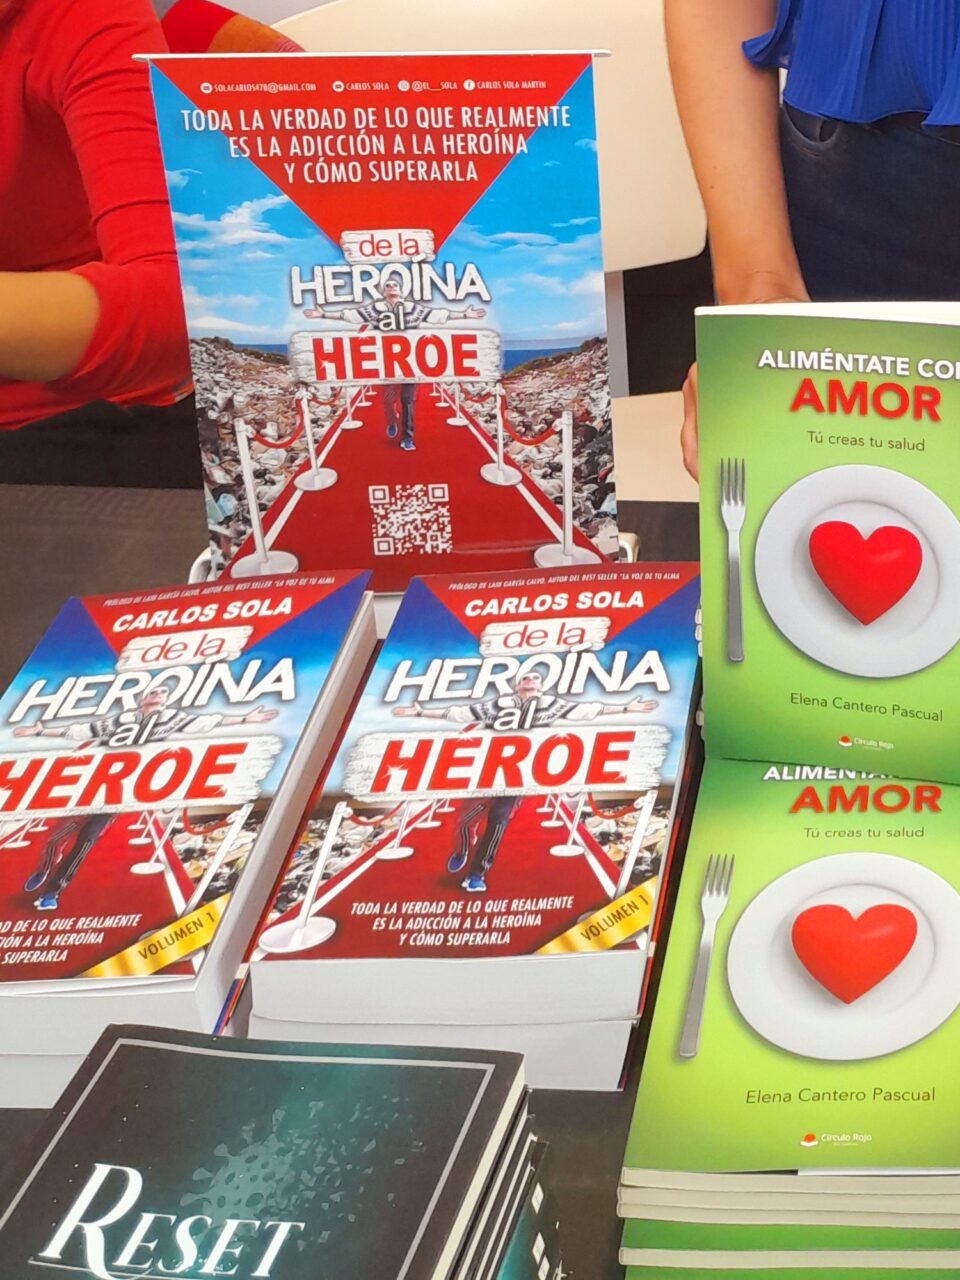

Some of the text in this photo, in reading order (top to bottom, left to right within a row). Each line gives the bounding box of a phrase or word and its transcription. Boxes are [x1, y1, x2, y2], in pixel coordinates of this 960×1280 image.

[346, 82, 372, 90] CARLOS
[373, 82, 389, 90] SOLA
[477, 81, 501, 89] CARLOS
[503, 81, 520, 89] SOLA
[181, 106, 571, 131] TODA LA VERDAD DE LO QUE REALMENTE
[229, 128, 528, 158] ES LA ADICCIÓN A LA HEROÍNA
[284, 158, 478, 183] Y CÓMO SUPERARLA
[359, 233, 419, 257] de la
[290, 254, 490, 306] HEROÍNA
[379, 306, 405, 331] al
[312, 324, 480, 381] HÉROE
[758, 348, 911, 377] ALIMÉNTATE
[790, 378, 942, 422] AMOR
[807, 431, 926, 452] Tú creas tu salud
[113, 597, 292, 632] CARLOS SOLA
[465, 591, 644, 617] CARLOS SOLA
[141, 634, 225, 663] de la
[503, 622, 586, 648] de la
[384, 646, 670, 703] HEROÍNA
[10, 657, 296, 722] HEROÍNA
[494, 701, 535, 731] al
[790, 692, 944, 722] Elena Cantero Pascual
[109, 714, 154, 748] al
[370, 723, 635, 793] HÉROE
[0, 740, 248, 812] HÉROE
[789, 784, 942, 814] AMOR
[804, 827, 925, 838] Tú creas tu salud
[351, 896, 574, 916] TODA LA VERDAD DE LO QUE REALMENTE
[579, 894, 649, 944] VOLUMEN 1
[372, 912, 542, 930] ES LA ADICCIÓN A LA HEROÍNA
[138, 912, 215, 960] VOLUMEN 1
[399, 929, 511, 946] Y CÓMO SUPERARLA
[745, 1086, 936, 1105] Elena Cantero Pascual
[853, 1132, 872, 1144] Rojo
